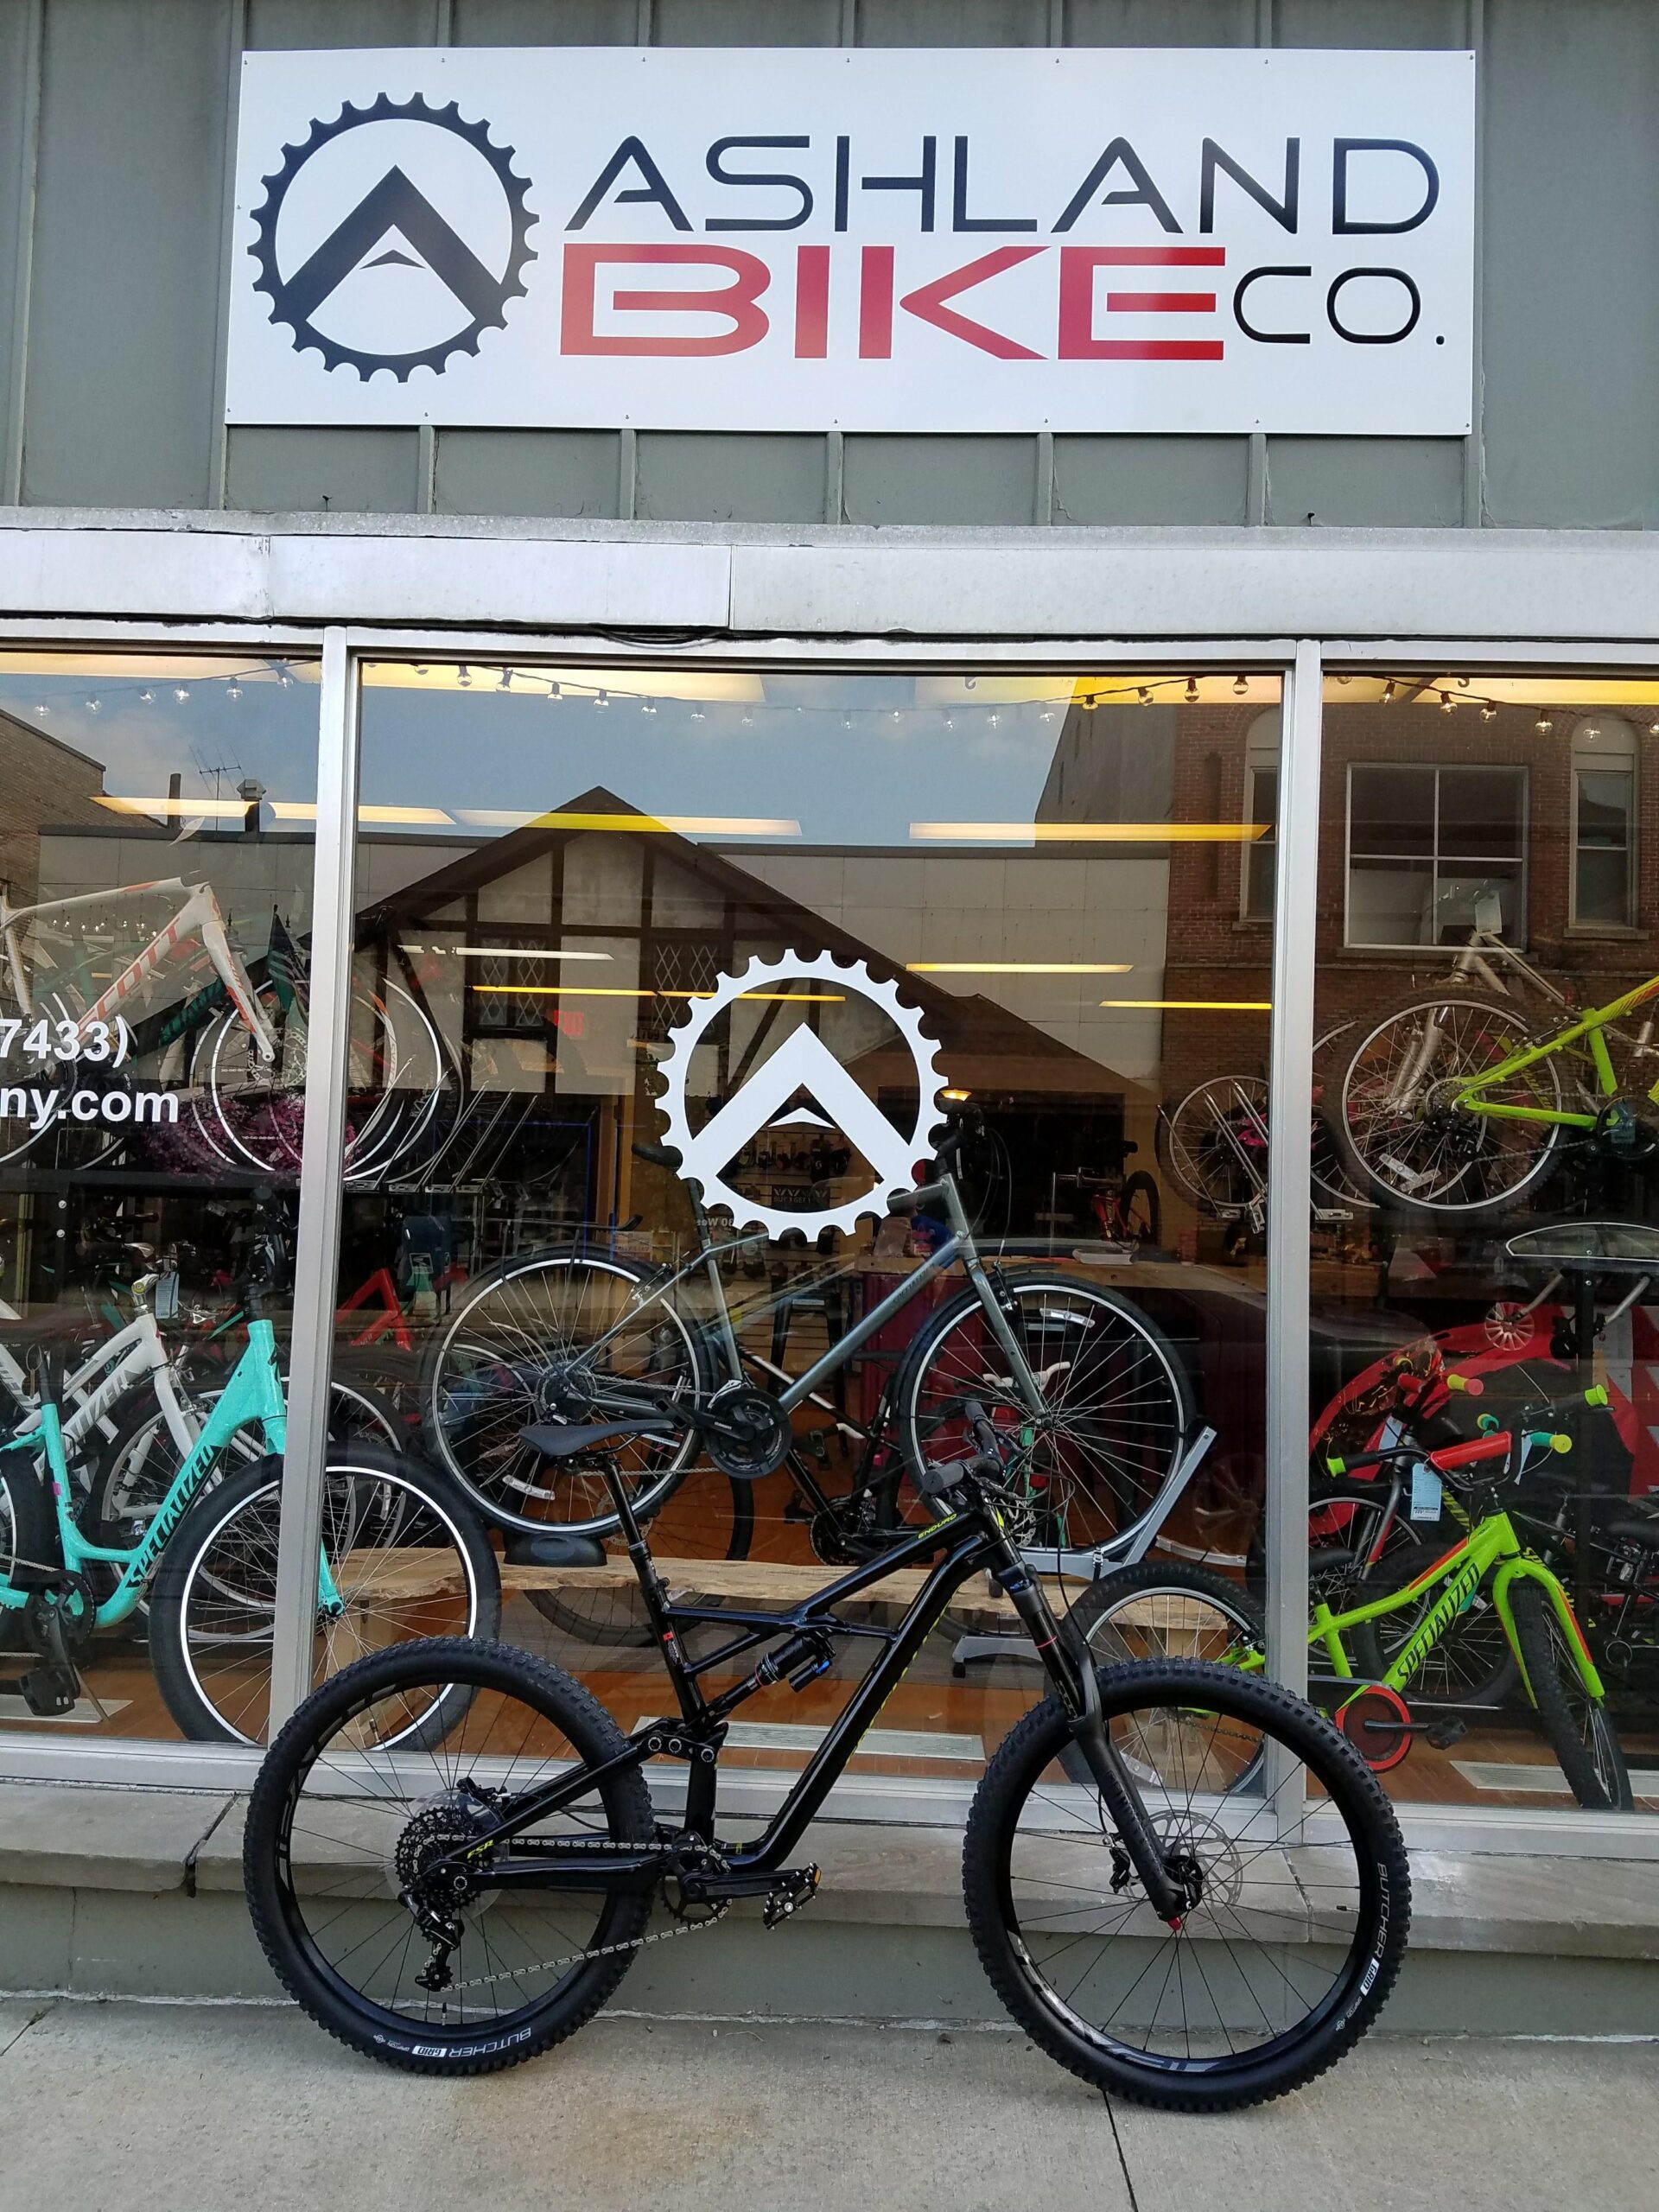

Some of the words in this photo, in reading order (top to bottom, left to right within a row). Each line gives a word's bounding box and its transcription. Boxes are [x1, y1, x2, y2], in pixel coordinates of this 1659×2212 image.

[563, 135, 1441, 235] ASHLAND
[560, 243, 1226, 361] BIKE
[1233, 265, 1446, 346] CO.
[0, 1087, 179, 1130] ny.com
[126, 1444, 219, 1588] SPECIALIZED
[918, 1513, 957, 1540] ENDURO
[1396, 1562, 1480, 1681] SPECIALIZED
[467, 1840, 493, 1859] FSR
[1374, 1862, 1390, 1959] BUTCHER
[448, 2027, 531, 2058] BUTCHER
